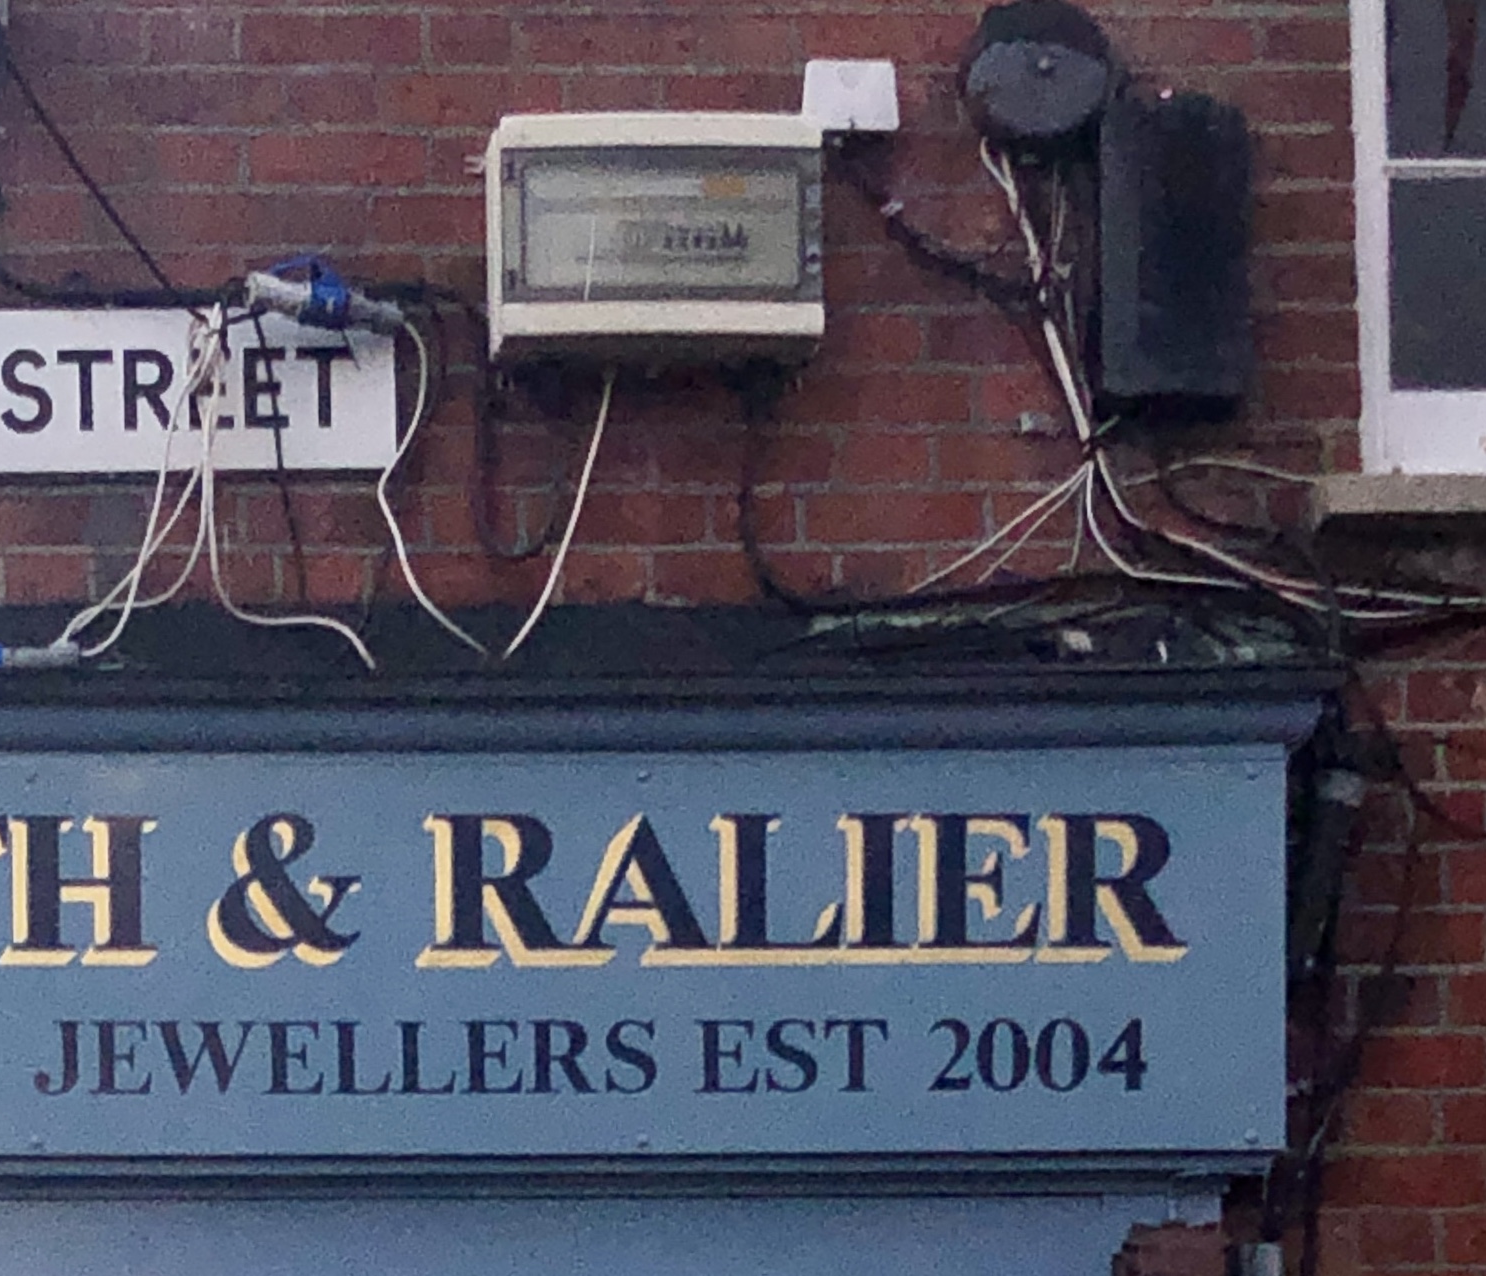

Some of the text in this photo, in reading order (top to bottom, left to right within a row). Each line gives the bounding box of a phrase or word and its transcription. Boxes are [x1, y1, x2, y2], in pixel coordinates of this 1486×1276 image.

[1, 346, 355, 433] STREET
[206, 811, 361, 970] &
[415, 811, 1190, 968] RALIER
[33, 1018, 657, 1096] JEWELLERS
[693, 1018, 888, 1094] EST
[928, 1017, 1149, 1093] 2004
